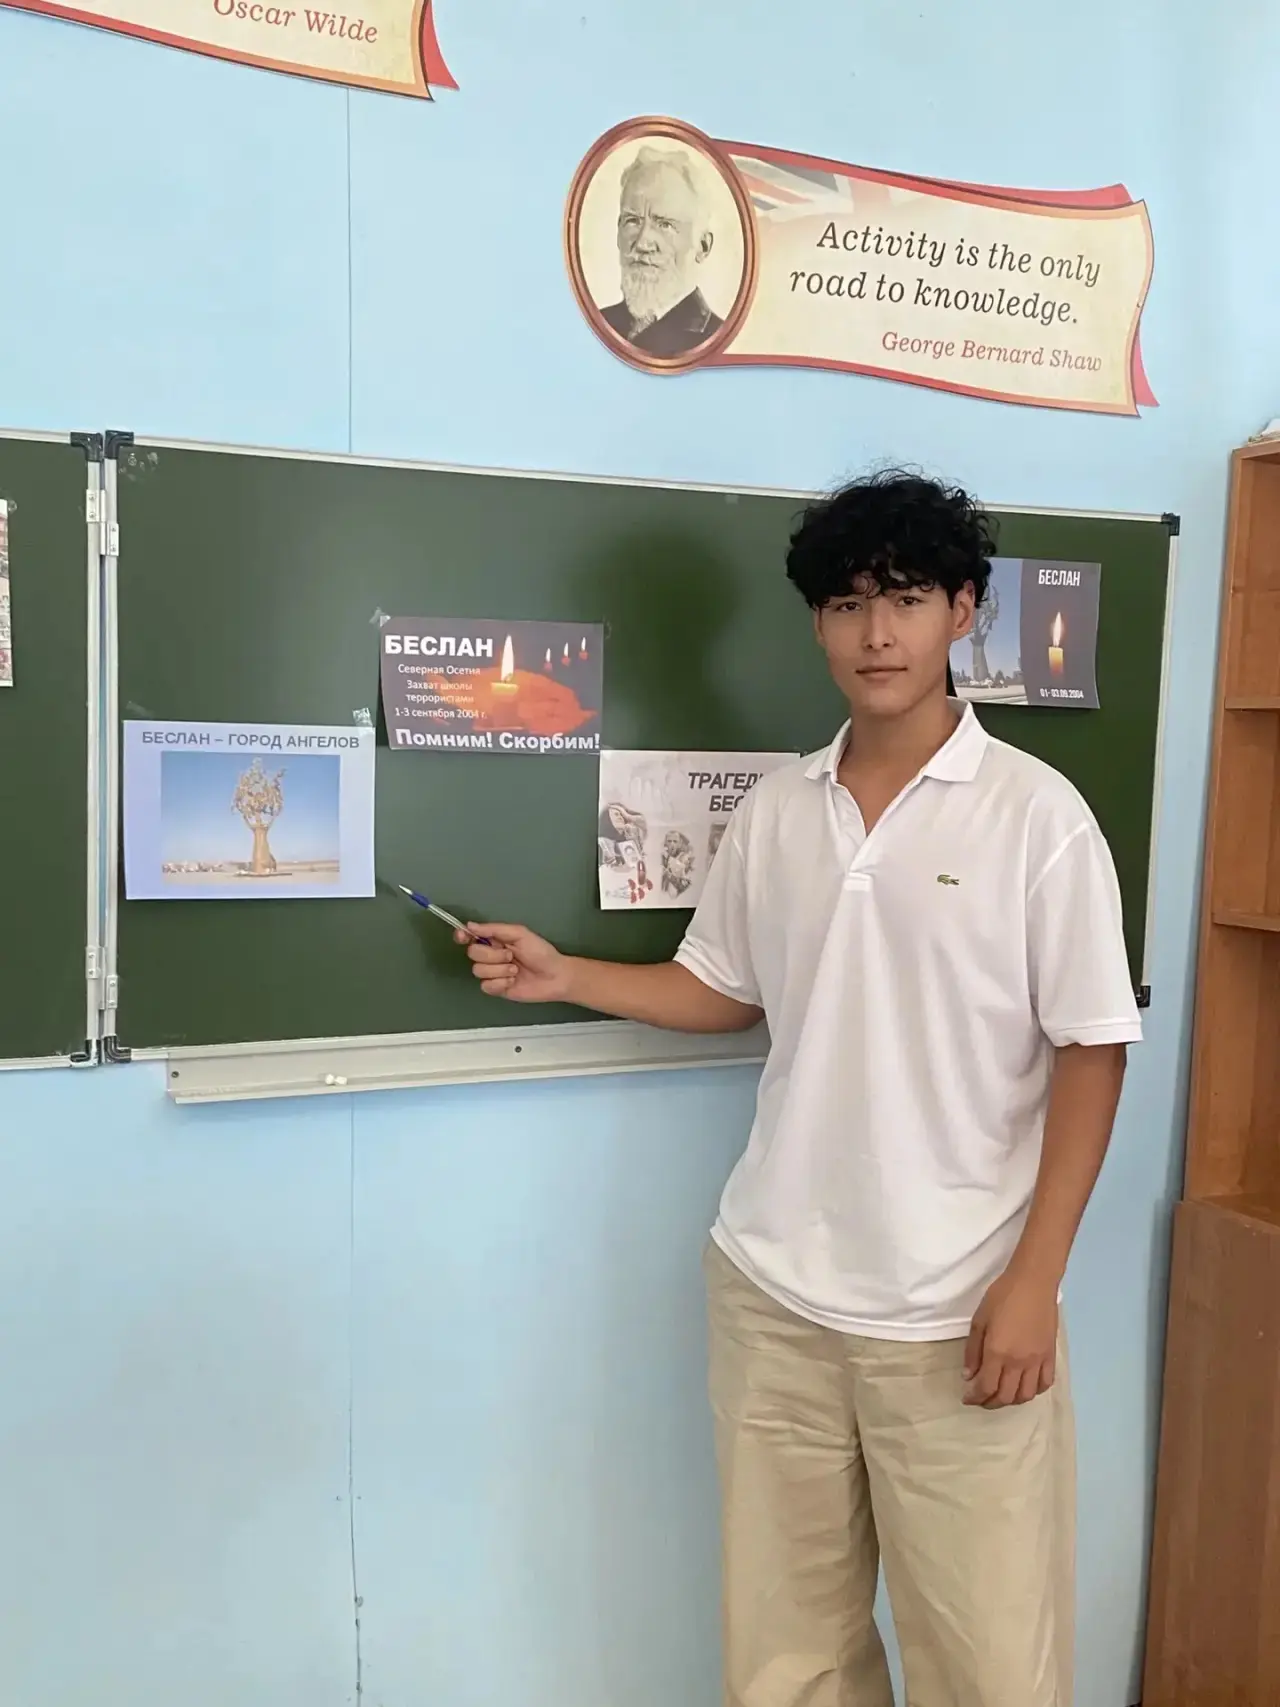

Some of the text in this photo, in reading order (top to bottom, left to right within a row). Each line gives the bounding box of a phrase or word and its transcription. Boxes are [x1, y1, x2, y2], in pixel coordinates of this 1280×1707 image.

[214, 0, 378, 44] Oscar Wilde
[816, 221, 1101, 288] Activity is the only
[789, 270, 1078, 326] road to knowledge.
[881, 331, 1102, 372] George Bernard Shaw
[1038, 569, 1081, 587] БЕСЛАН
[384, 635, 493, 658] БЕСЛАН
[398, 664, 481, 676] Северная Осетия
[407, 680, 473, 691] Захват школы
[406, 693, 474, 704] террористами
[395, 708, 410, 717] 1-3
[412, 709, 455, 720] сентября
[457, 709, 479, 719] 2004
[142, 731, 210, 745] БЕСЛАН
[228, 733, 282, 750] ГОРОД
[286, 735, 360, 748] АНГЕЛОВ
[396, 729, 600, 752] Помним! Скорбим!
[688, 772, 764, 792] ТРАГЕД
